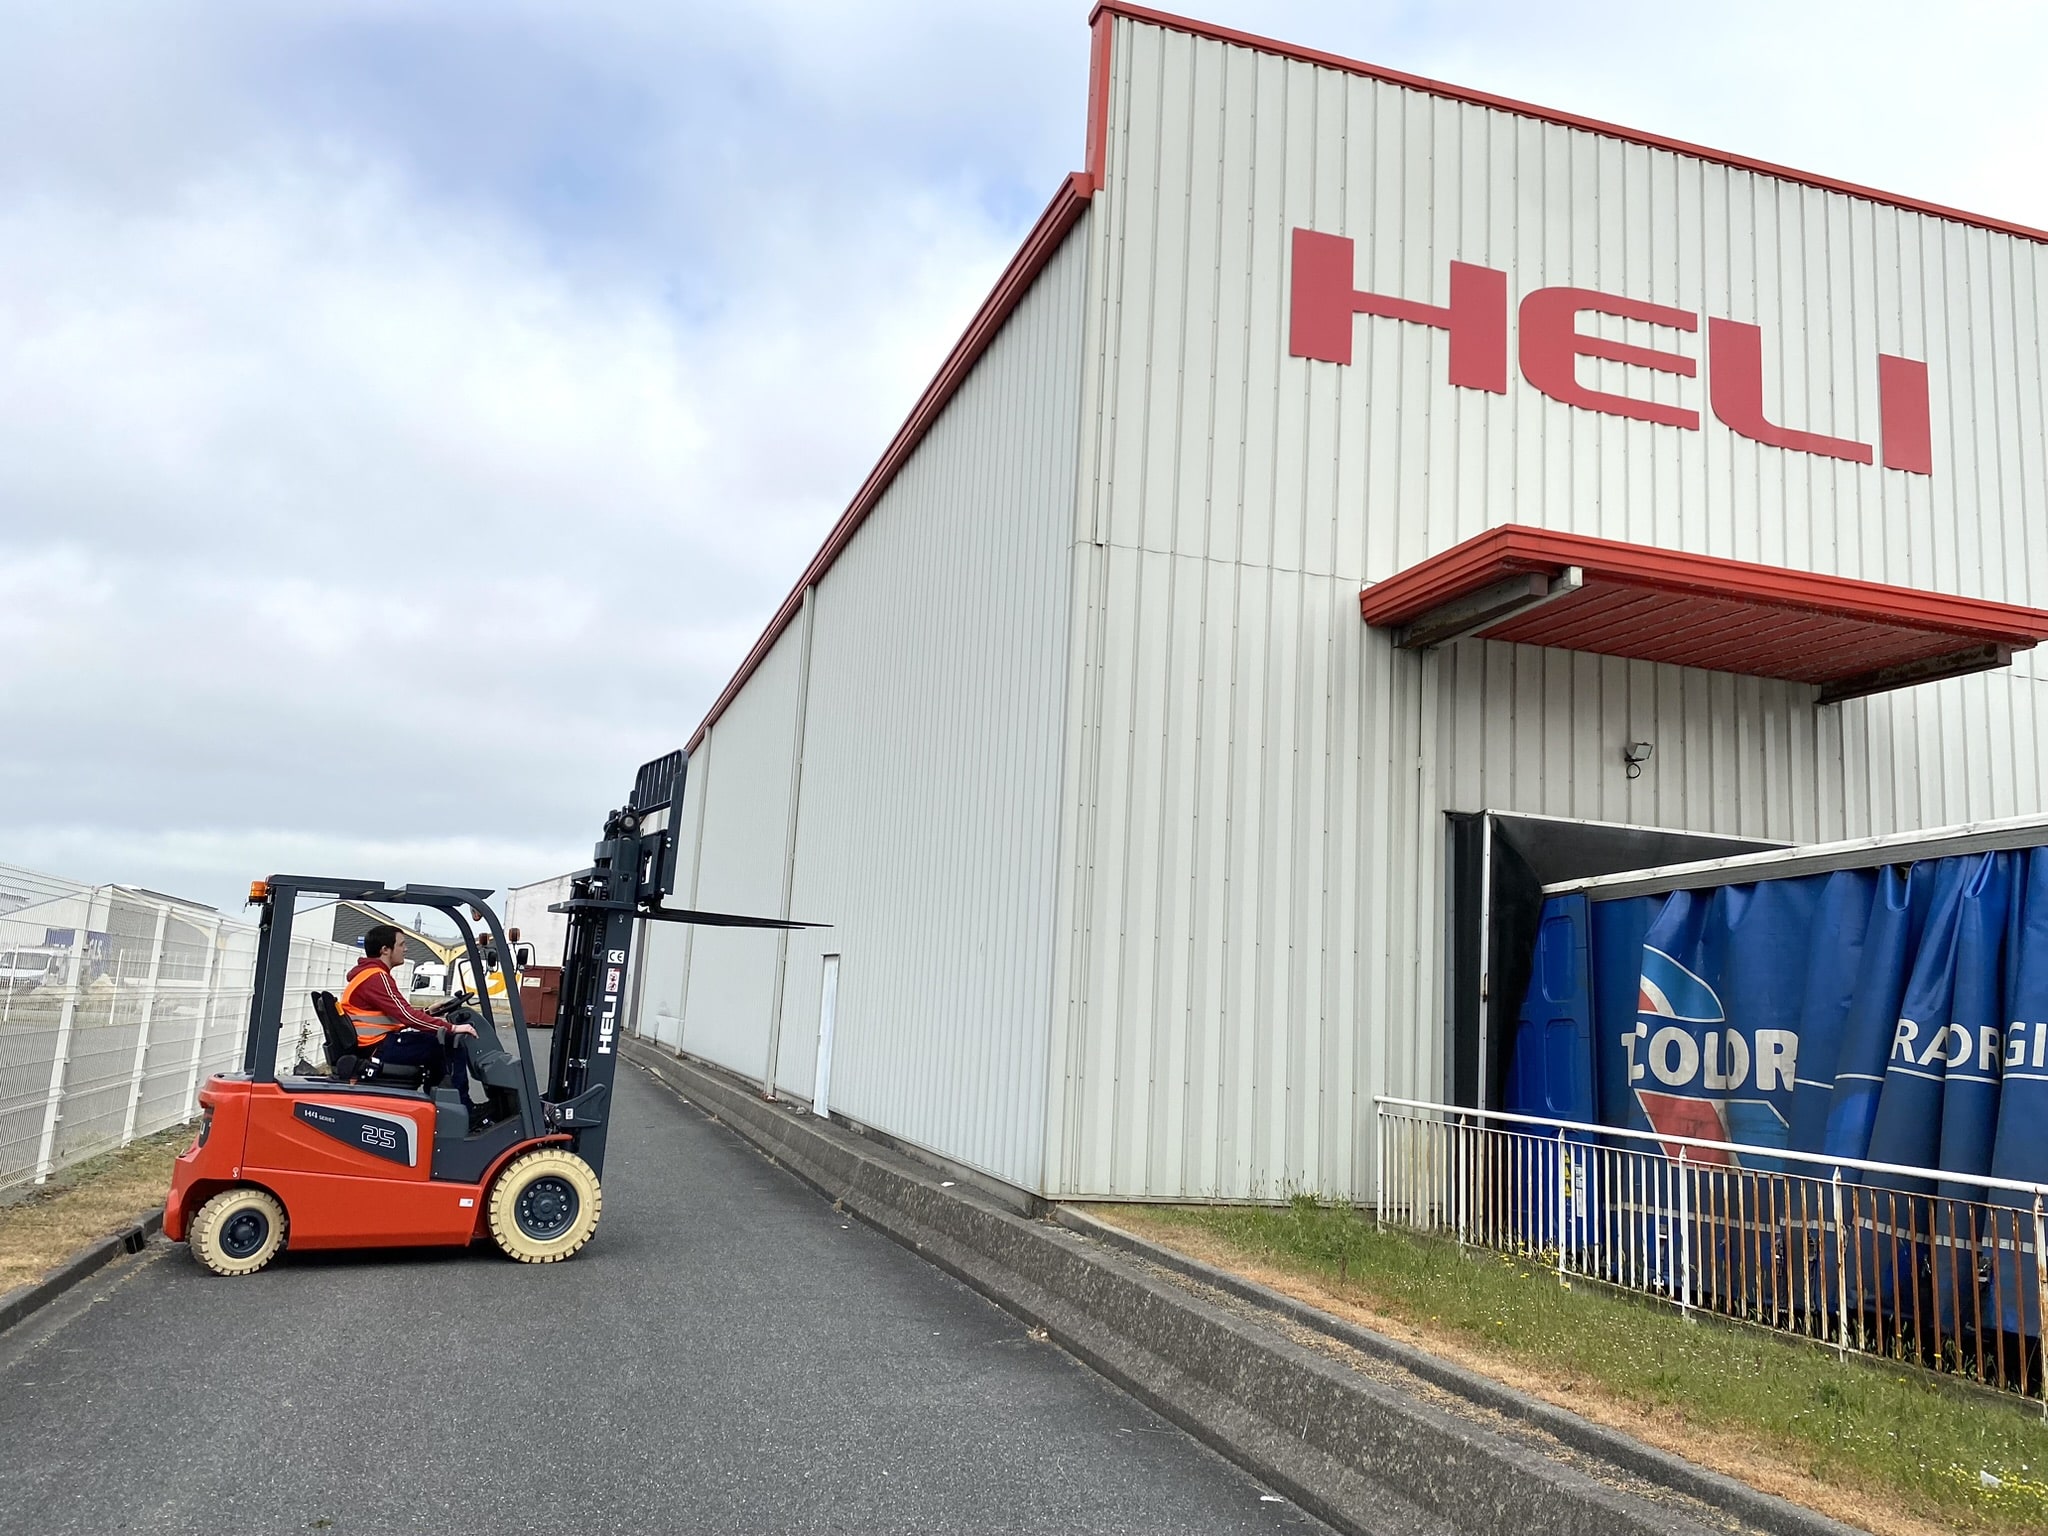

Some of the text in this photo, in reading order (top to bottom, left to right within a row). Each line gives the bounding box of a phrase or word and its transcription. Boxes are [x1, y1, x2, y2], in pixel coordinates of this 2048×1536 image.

[1290, 227, 1932, 475] HELI
[598, 995, 617, 1054] HELI
[361, 1124, 396, 1149] 25
